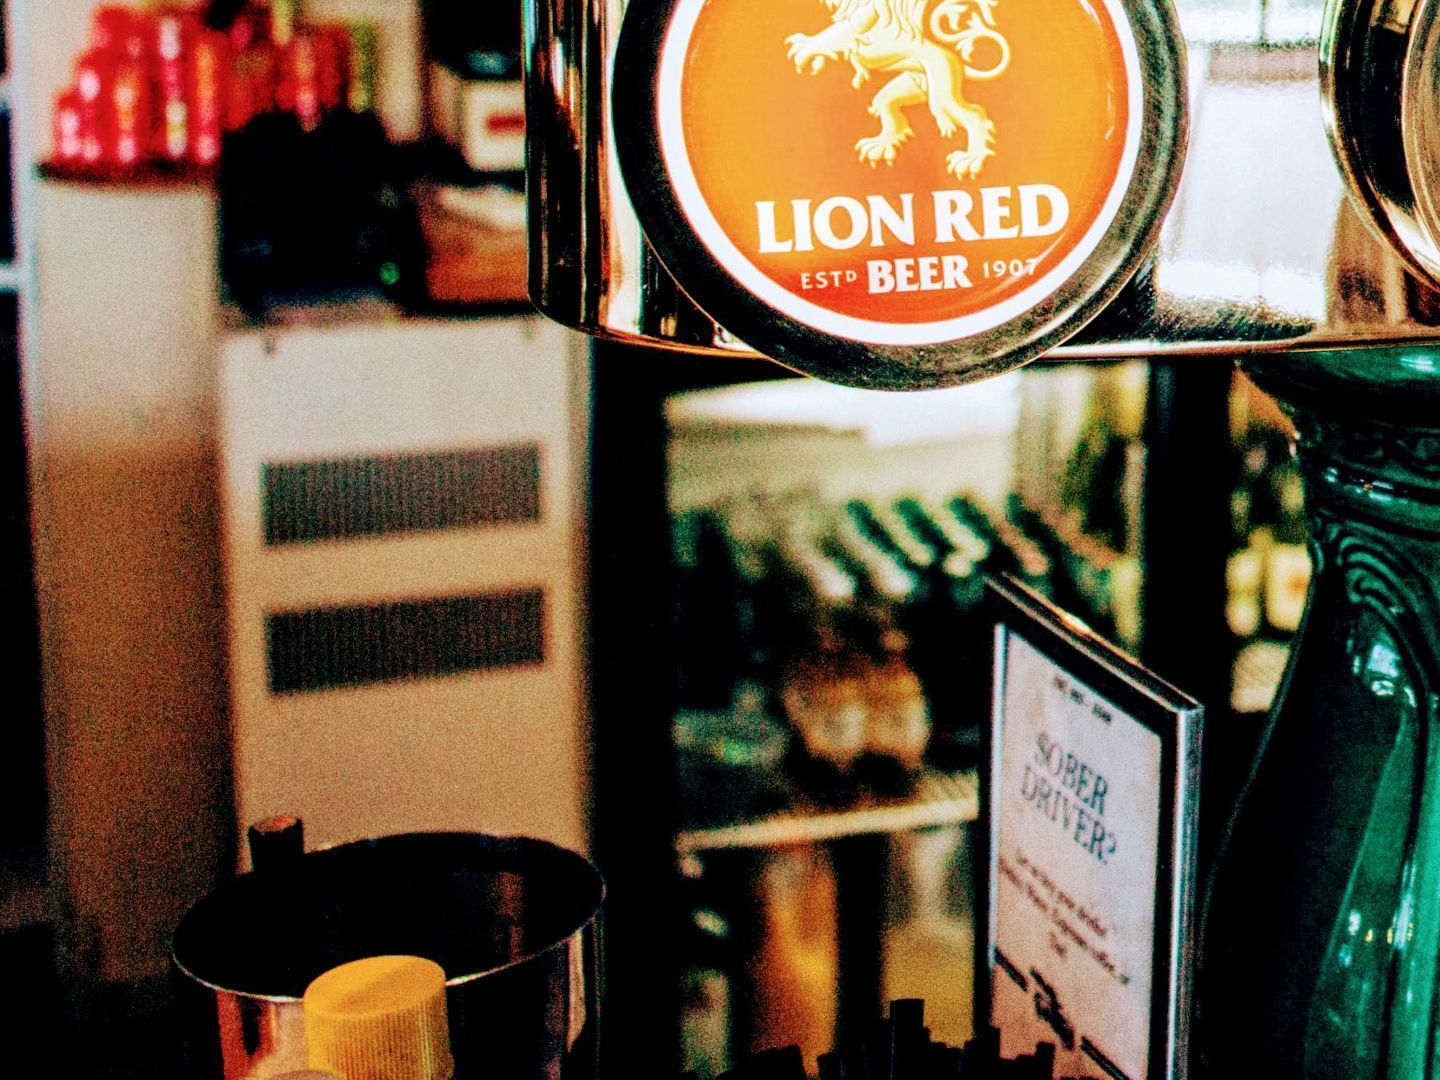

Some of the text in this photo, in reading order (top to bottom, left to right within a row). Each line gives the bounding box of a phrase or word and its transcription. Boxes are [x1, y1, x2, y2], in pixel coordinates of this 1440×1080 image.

[754, 183, 1070, 254] LION RED
[801, 255, 1037, 294] ESTD BEER 1907
[1034, 733, 1109, 816] SOBER
[1021, 765, 1118, 866] DRIVER?
